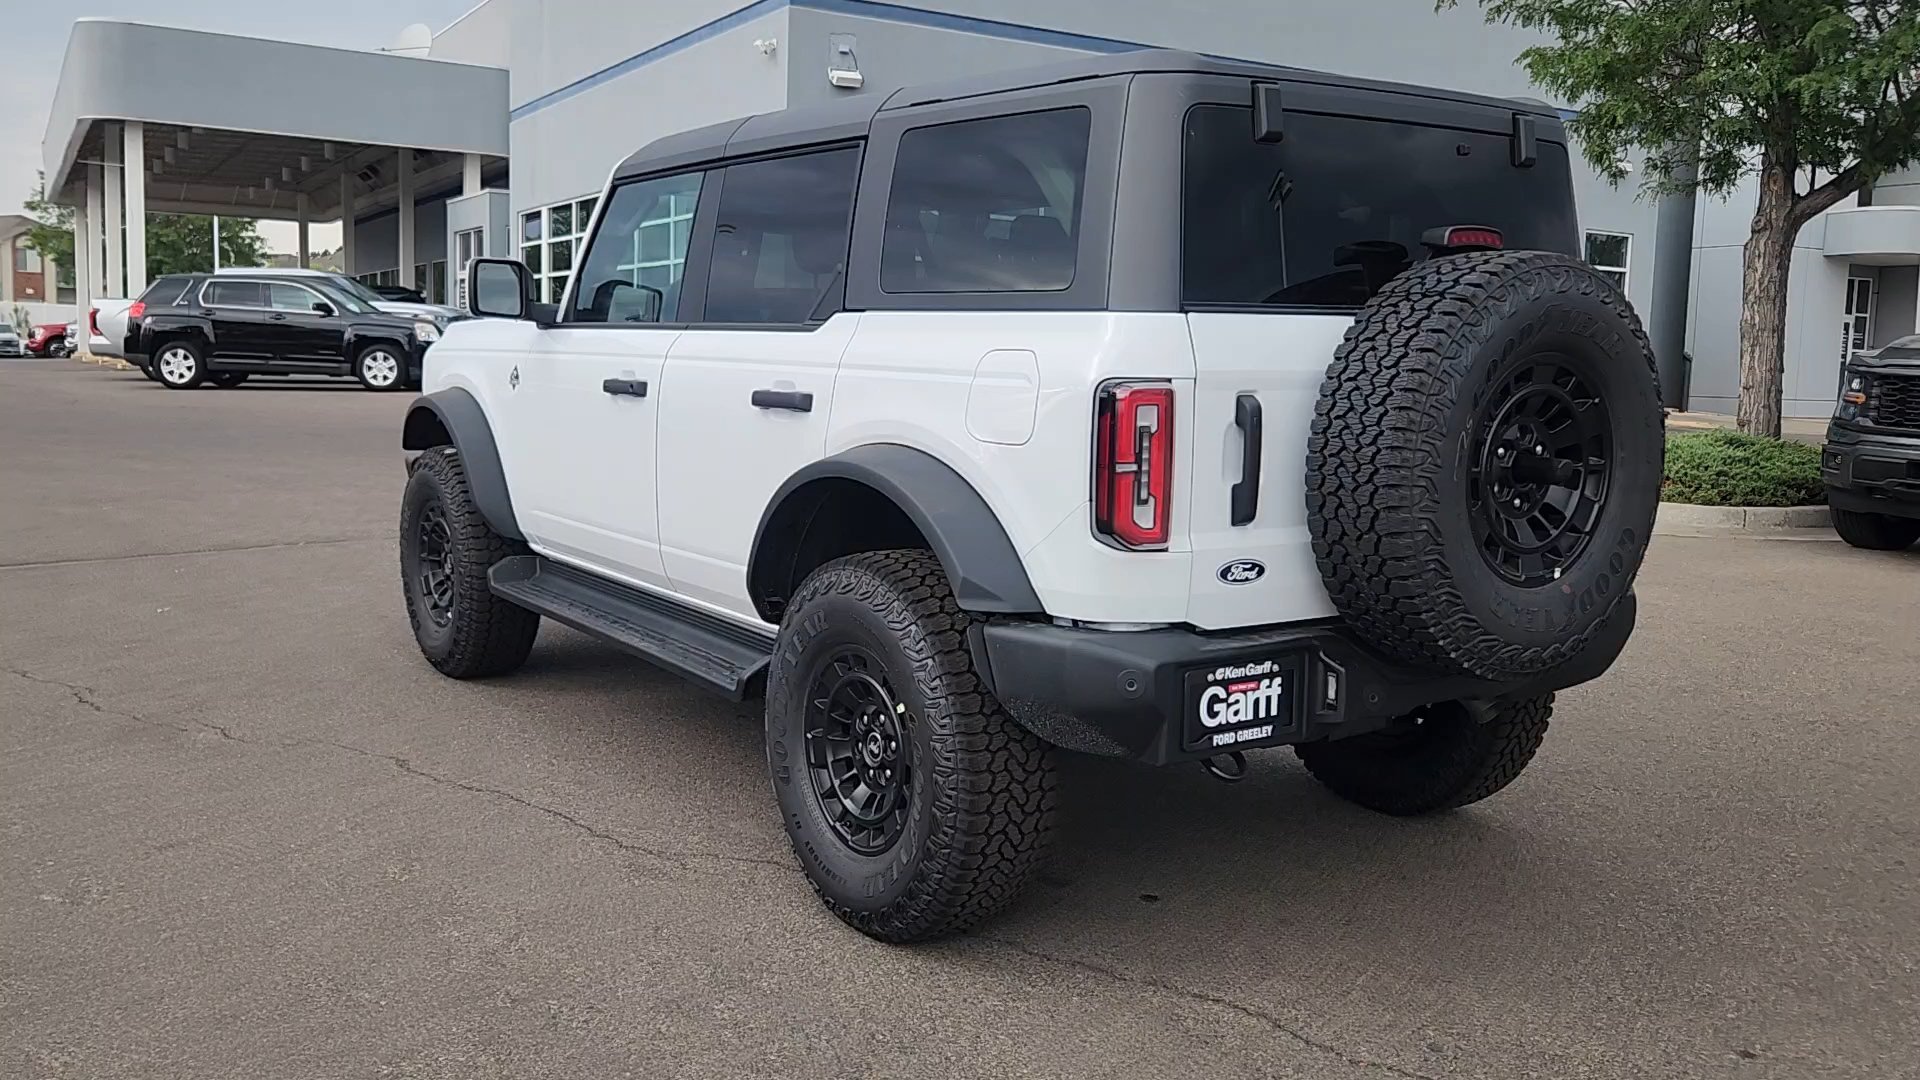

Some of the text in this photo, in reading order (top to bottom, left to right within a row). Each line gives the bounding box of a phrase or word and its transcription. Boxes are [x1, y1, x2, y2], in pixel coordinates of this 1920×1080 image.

[1227, 563, 1259, 581] Ford
[1199, 677, 1282, 728] Garff
[1213, 725, 1274, 747] FORD GREELEY
